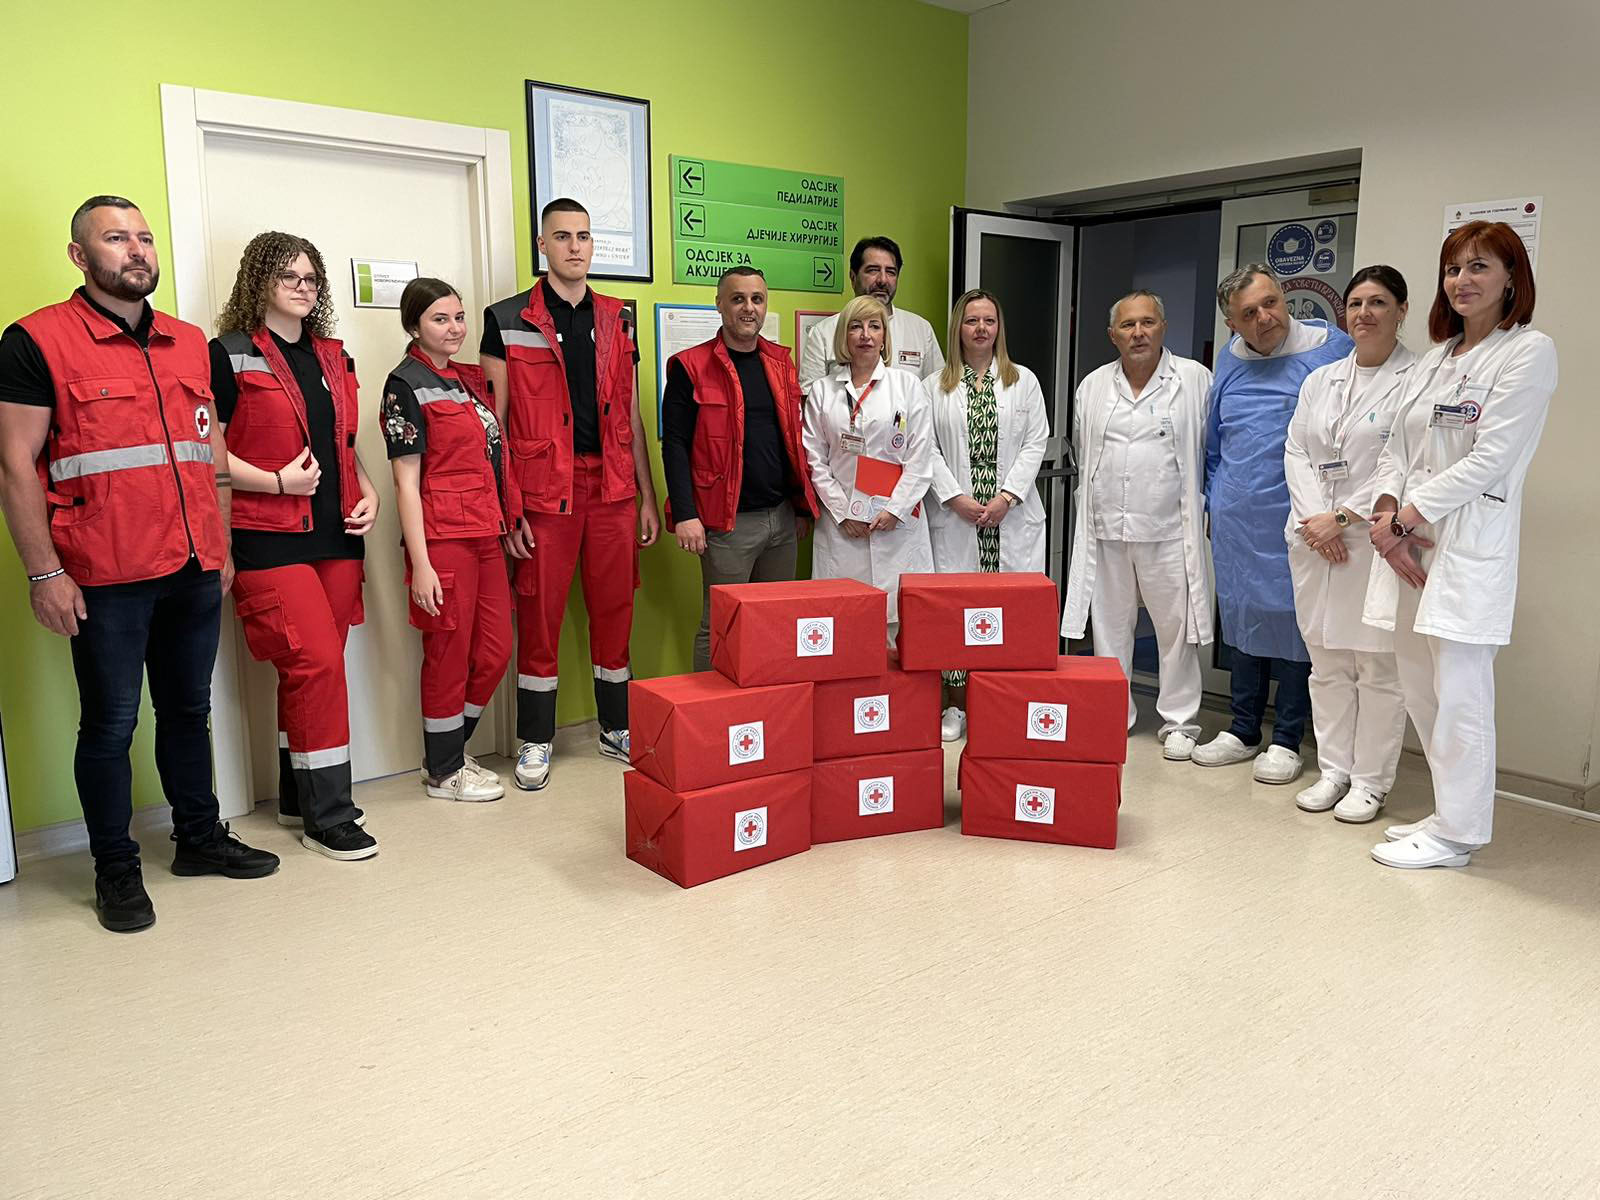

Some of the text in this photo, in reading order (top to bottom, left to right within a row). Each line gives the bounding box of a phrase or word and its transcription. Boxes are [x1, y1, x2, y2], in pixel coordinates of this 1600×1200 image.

[801, 178, 838, 194] ОДСЈЕК
[777, 191, 838, 208] ПЕДИЈАТРИЈЕ
[801, 218, 838, 232] ОДСЈЕК
[747, 228, 838, 247] ДЈЕЧИЈЕ ХИРУРГИЈЕ
[685, 248, 752, 265] ОДСЈЕК ЗА
